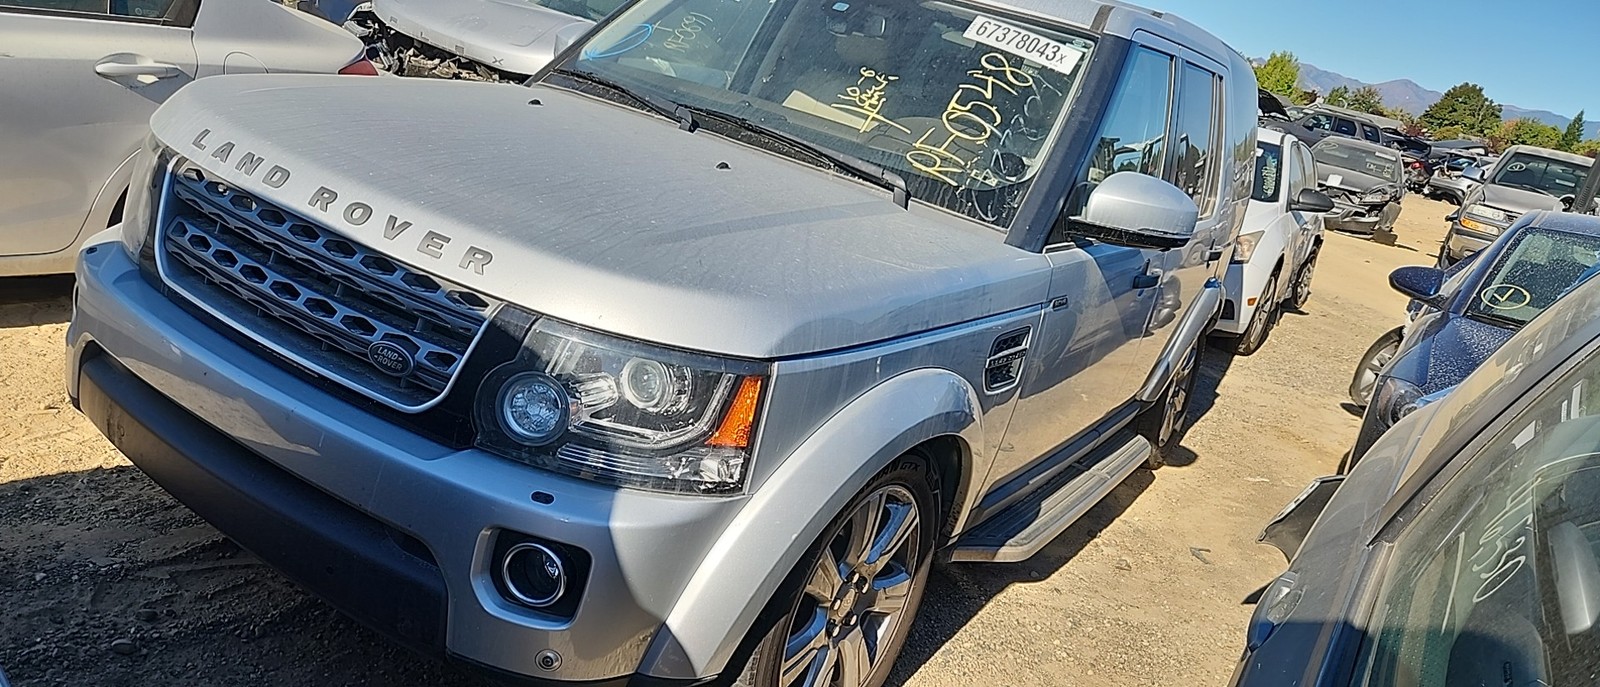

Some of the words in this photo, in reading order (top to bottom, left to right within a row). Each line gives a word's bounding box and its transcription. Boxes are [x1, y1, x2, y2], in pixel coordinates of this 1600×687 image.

[905, 52, 1033, 187] RF-0548
[192, 128, 291, 189] LAND
[308, 186, 494, 275] ROVER
